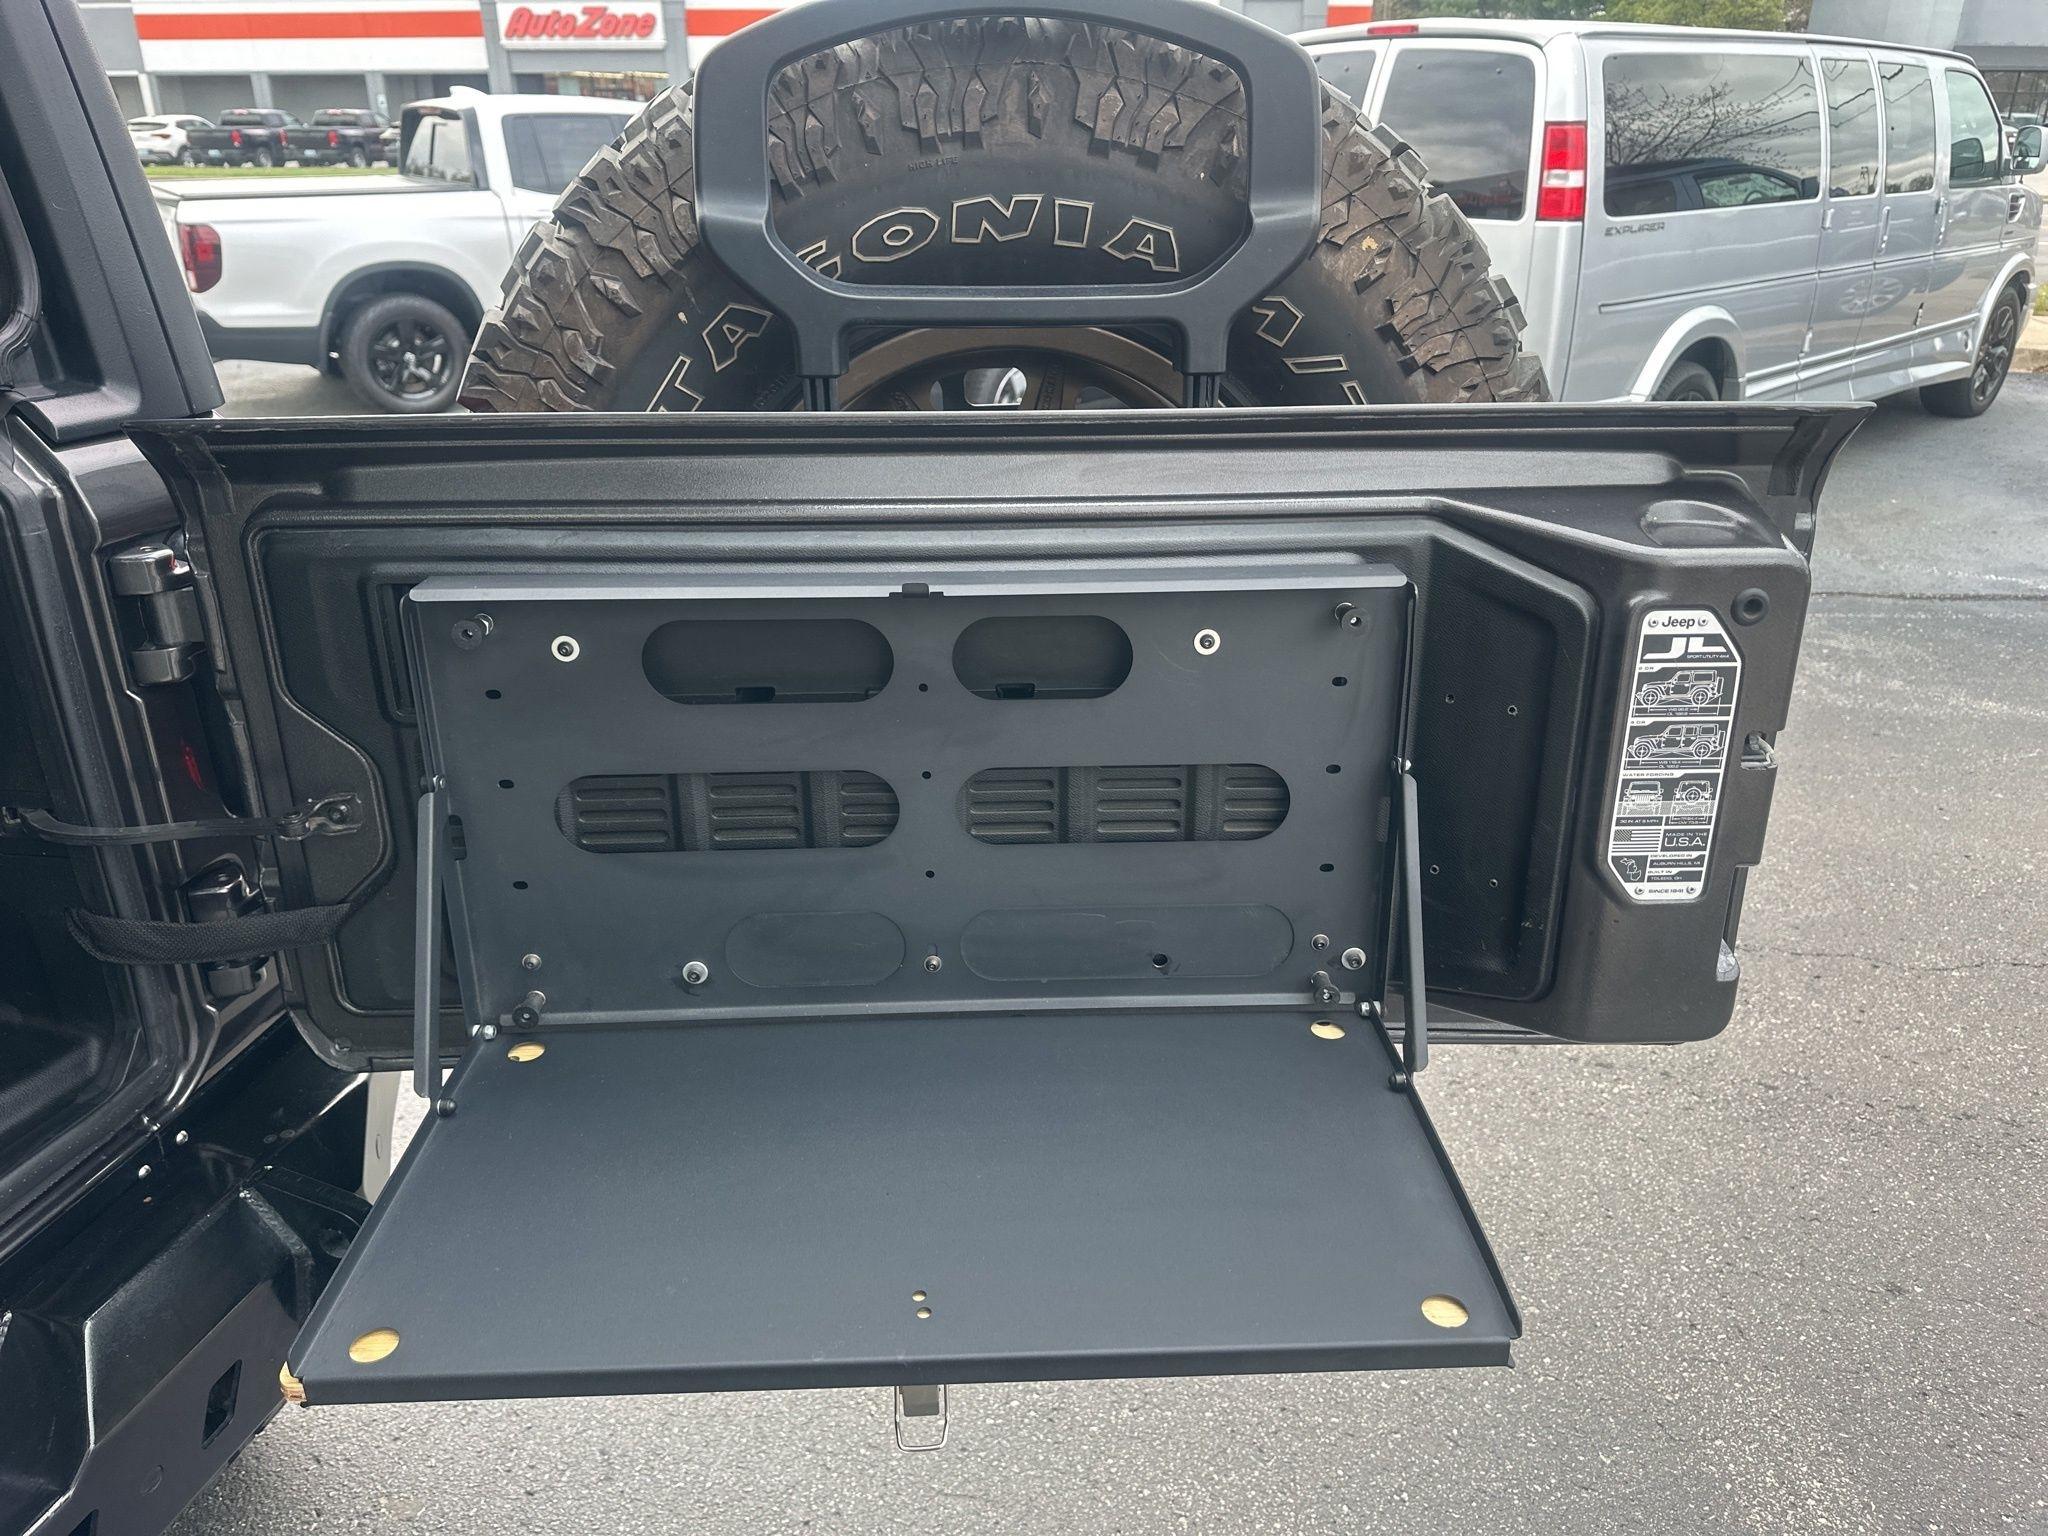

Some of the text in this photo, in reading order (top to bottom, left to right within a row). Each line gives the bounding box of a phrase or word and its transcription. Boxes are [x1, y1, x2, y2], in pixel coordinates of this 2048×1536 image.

[505, 6, 656, 38] AutoZone
[1662, 616, 1696, 629] Jeep
[1642, 637, 1727, 660] JL
[1664, 837, 1706, 847] U.S.A.
